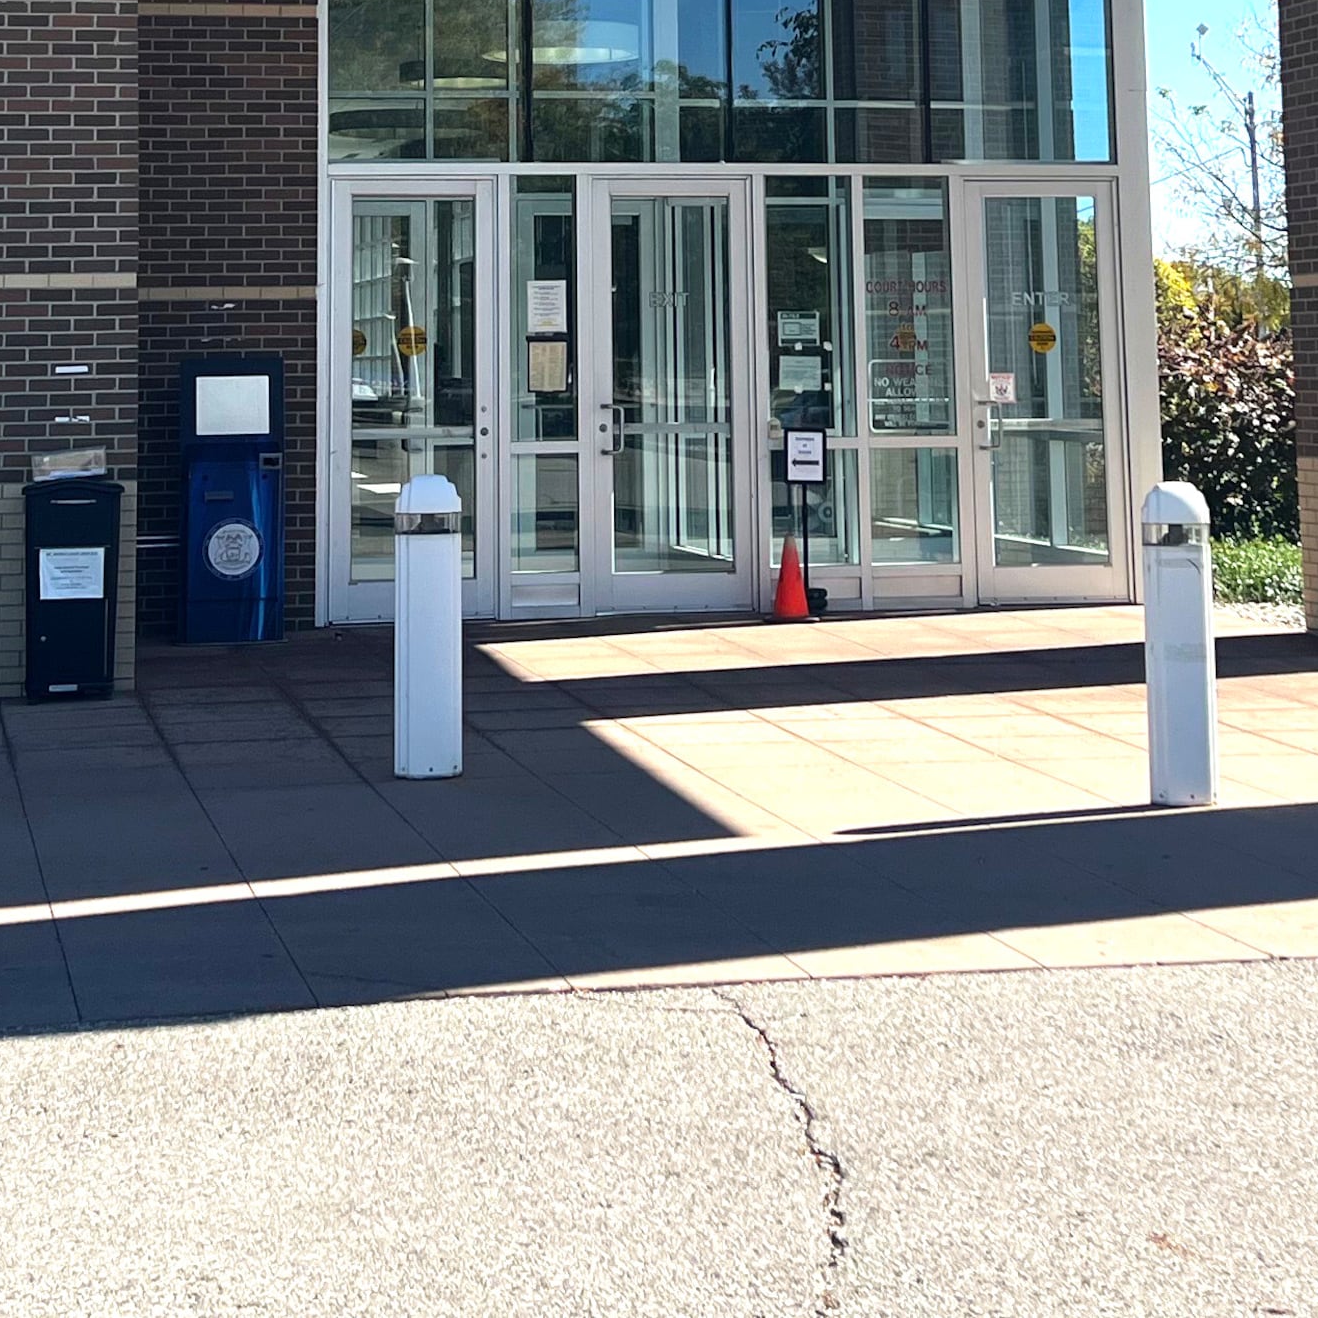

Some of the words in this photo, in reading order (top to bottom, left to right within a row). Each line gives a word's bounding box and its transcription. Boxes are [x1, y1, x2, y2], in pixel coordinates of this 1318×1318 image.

[648, 292, 691, 308] EXIT
[1011, 290, 1070, 307] ENTER
[888, 301, 899, 317] 8
[906, 304, 927, 317] AM
[889, 334, 900, 351] 4
[908, 339, 929, 351] PM
[874, 376, 890, 388] NO
[892, 376, 945, 387] WEANS
